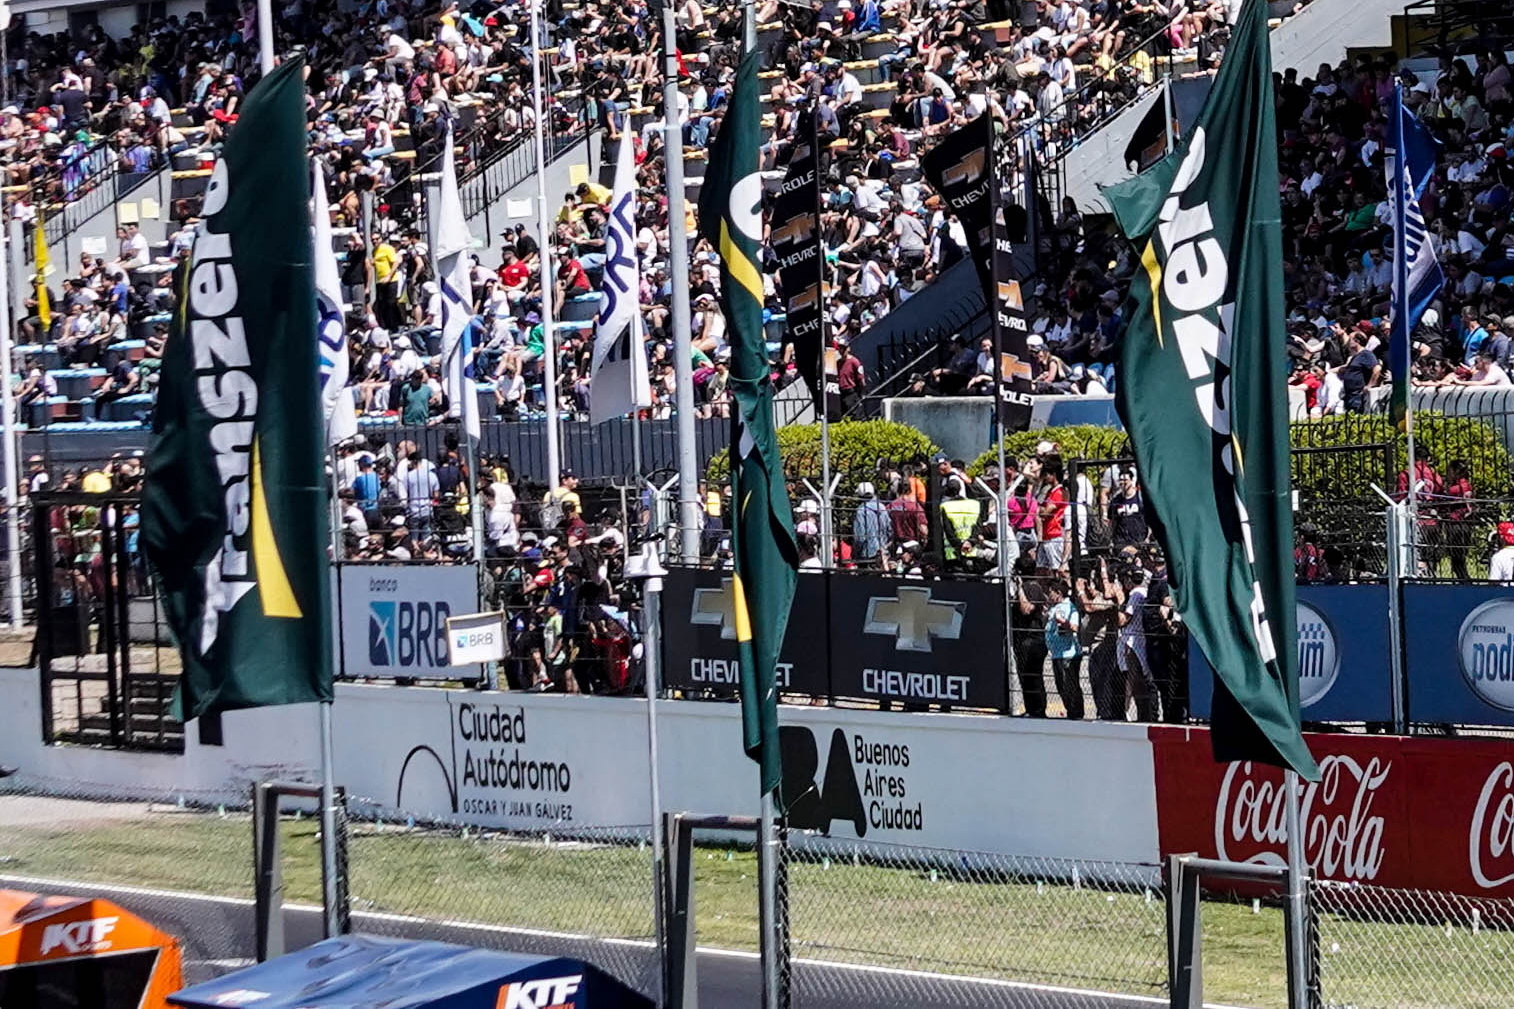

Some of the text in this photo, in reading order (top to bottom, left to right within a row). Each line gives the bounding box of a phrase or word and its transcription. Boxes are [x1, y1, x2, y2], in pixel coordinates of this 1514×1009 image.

[370, 576, 398, 592] banco
[470, 633, 493, 646] BRB
[691, 658, 793, 687] CHEVET
[863, 669, 970, 700] CHEVROLET
[459, 703, 525, 743] Ciudad
[854, 735, 909, 767] Buenos
[463, 748, 570, 792] Autódromo
[864, 769, 905, 797] Aires
[463, 799, 497, 815] OSCAR
[500, 800, 507, 815] Y
[509, 800, 532, 816] JUAN
[870, 800, 922, 830] Ciudad
[497, 974, 582, 1009] KTF
